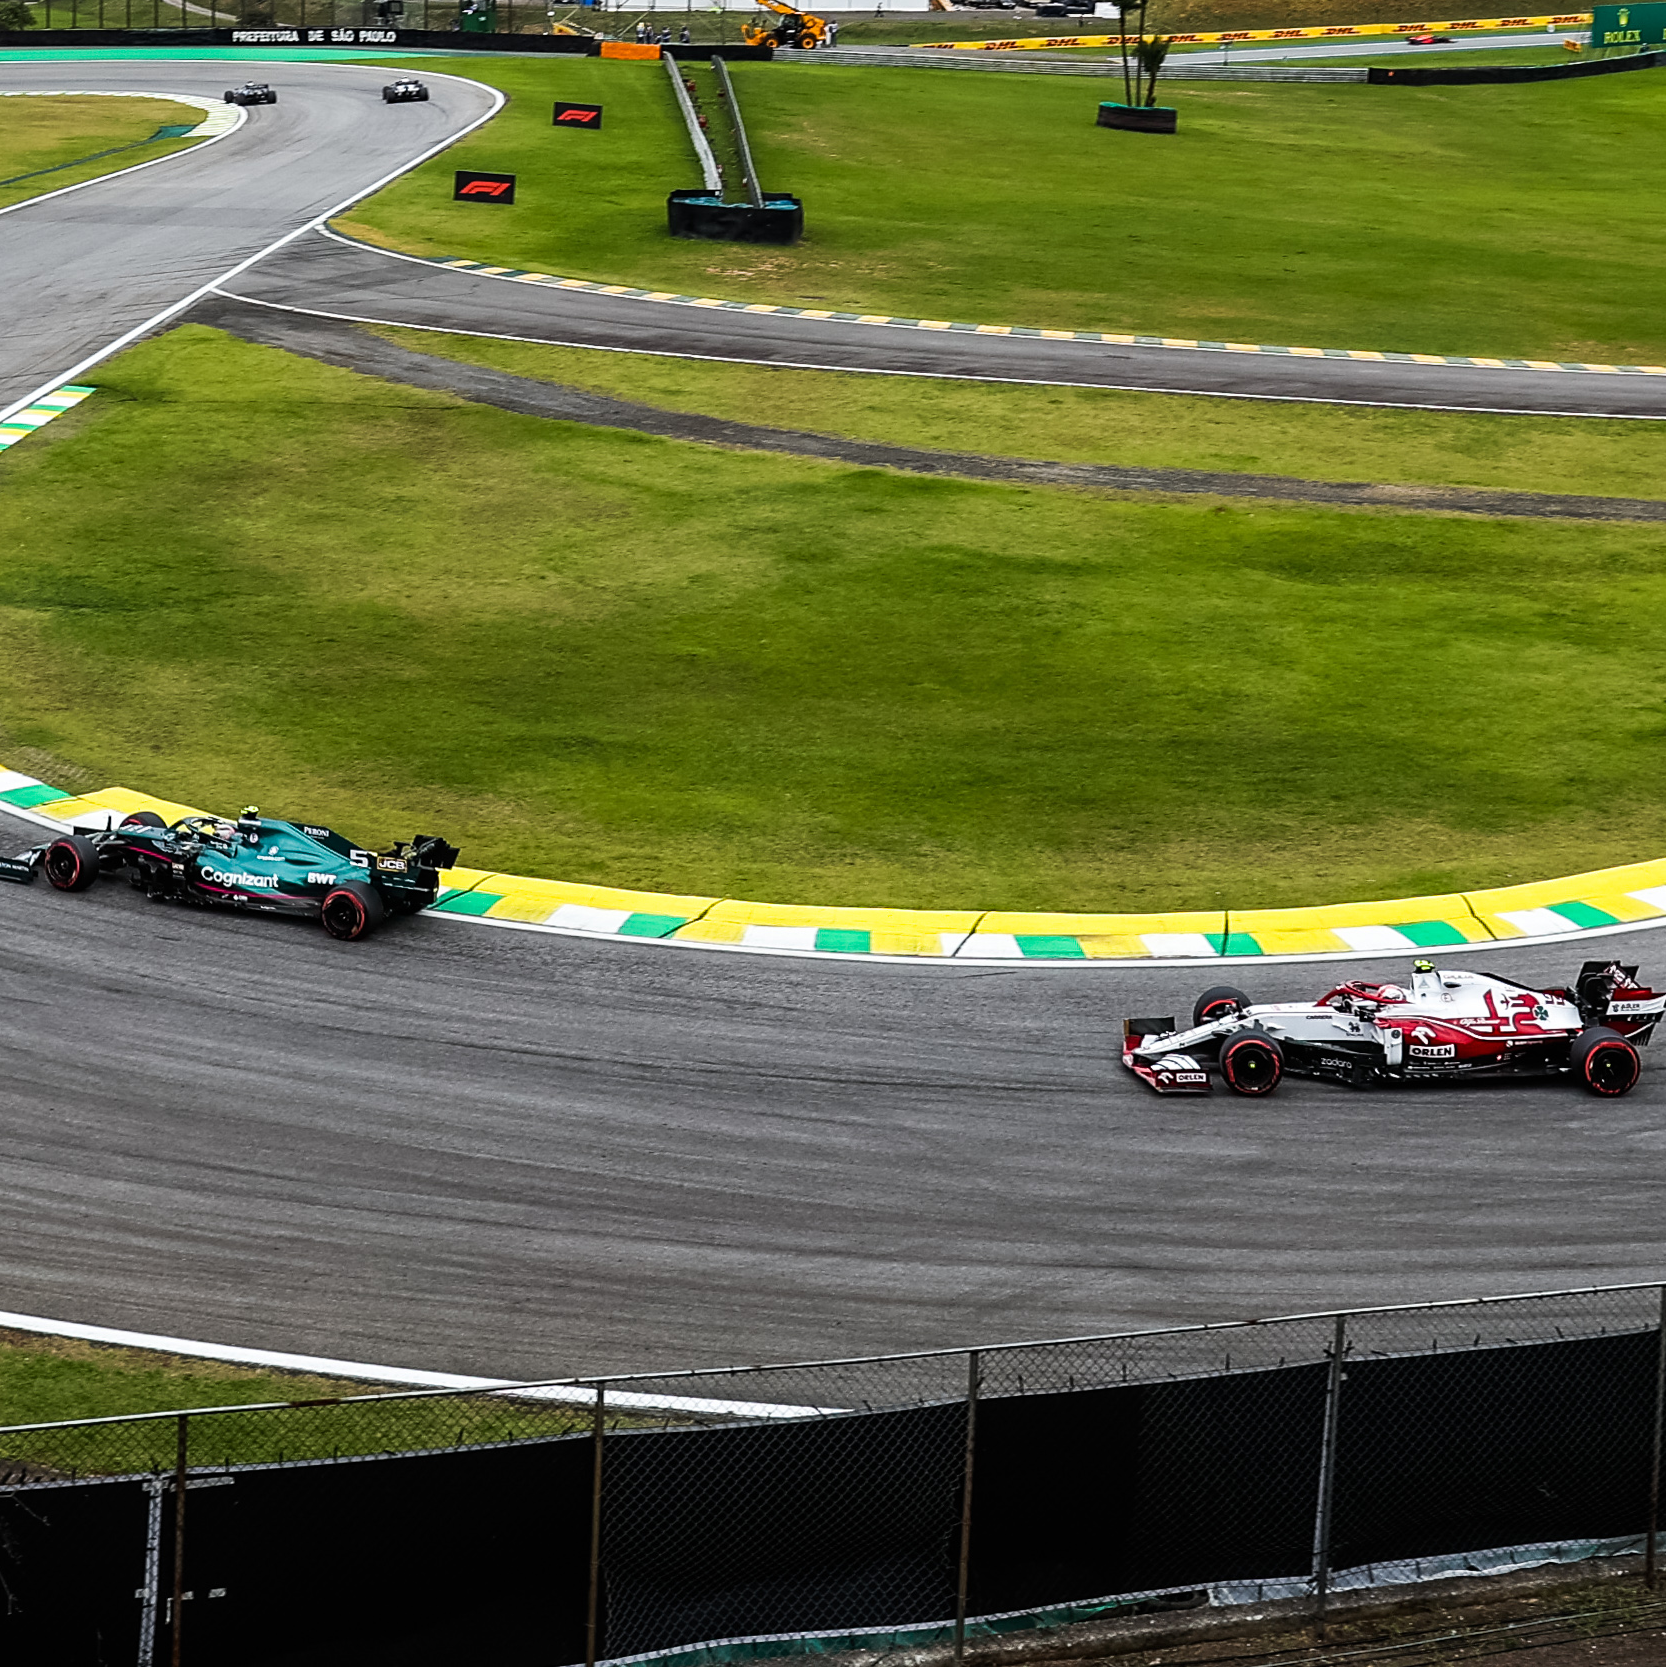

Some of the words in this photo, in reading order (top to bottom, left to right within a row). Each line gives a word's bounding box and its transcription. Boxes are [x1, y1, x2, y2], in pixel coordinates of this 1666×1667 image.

[1501, 18, 1528, 27] DHL
[1552, 16, 1580, 24] DHL
[1398, 24, 1426, 32] DHL
[1449, 21, 1477, 29] DHL
[232, 30, 299, 42] PREFEITURA
[308, 30, 325, 42] DE
[331, 27, 355, 42] SÃO
[359, 30, 397, 42] PAULO
[1274, 29, 1301, 38] DHL
[1326, 27, 1354, 35] DHL
[1221, 32, 1250, 40] DHL
[1604, 30, 1642, 44] ROLEX
[1046, 38, 1080, 47] DHL
[304, 826, 330, 837] PERONI
[350, 849, 369, 868] 5
[379, 859, 405, 870] JCB
[201, 865, 279, 888] Cognizant
[307, 872, 337, 885] BWT
[1412, 1047, 1452, 1056] ORLEN
[1178, 1073, 1204, 1081] ORLEN
